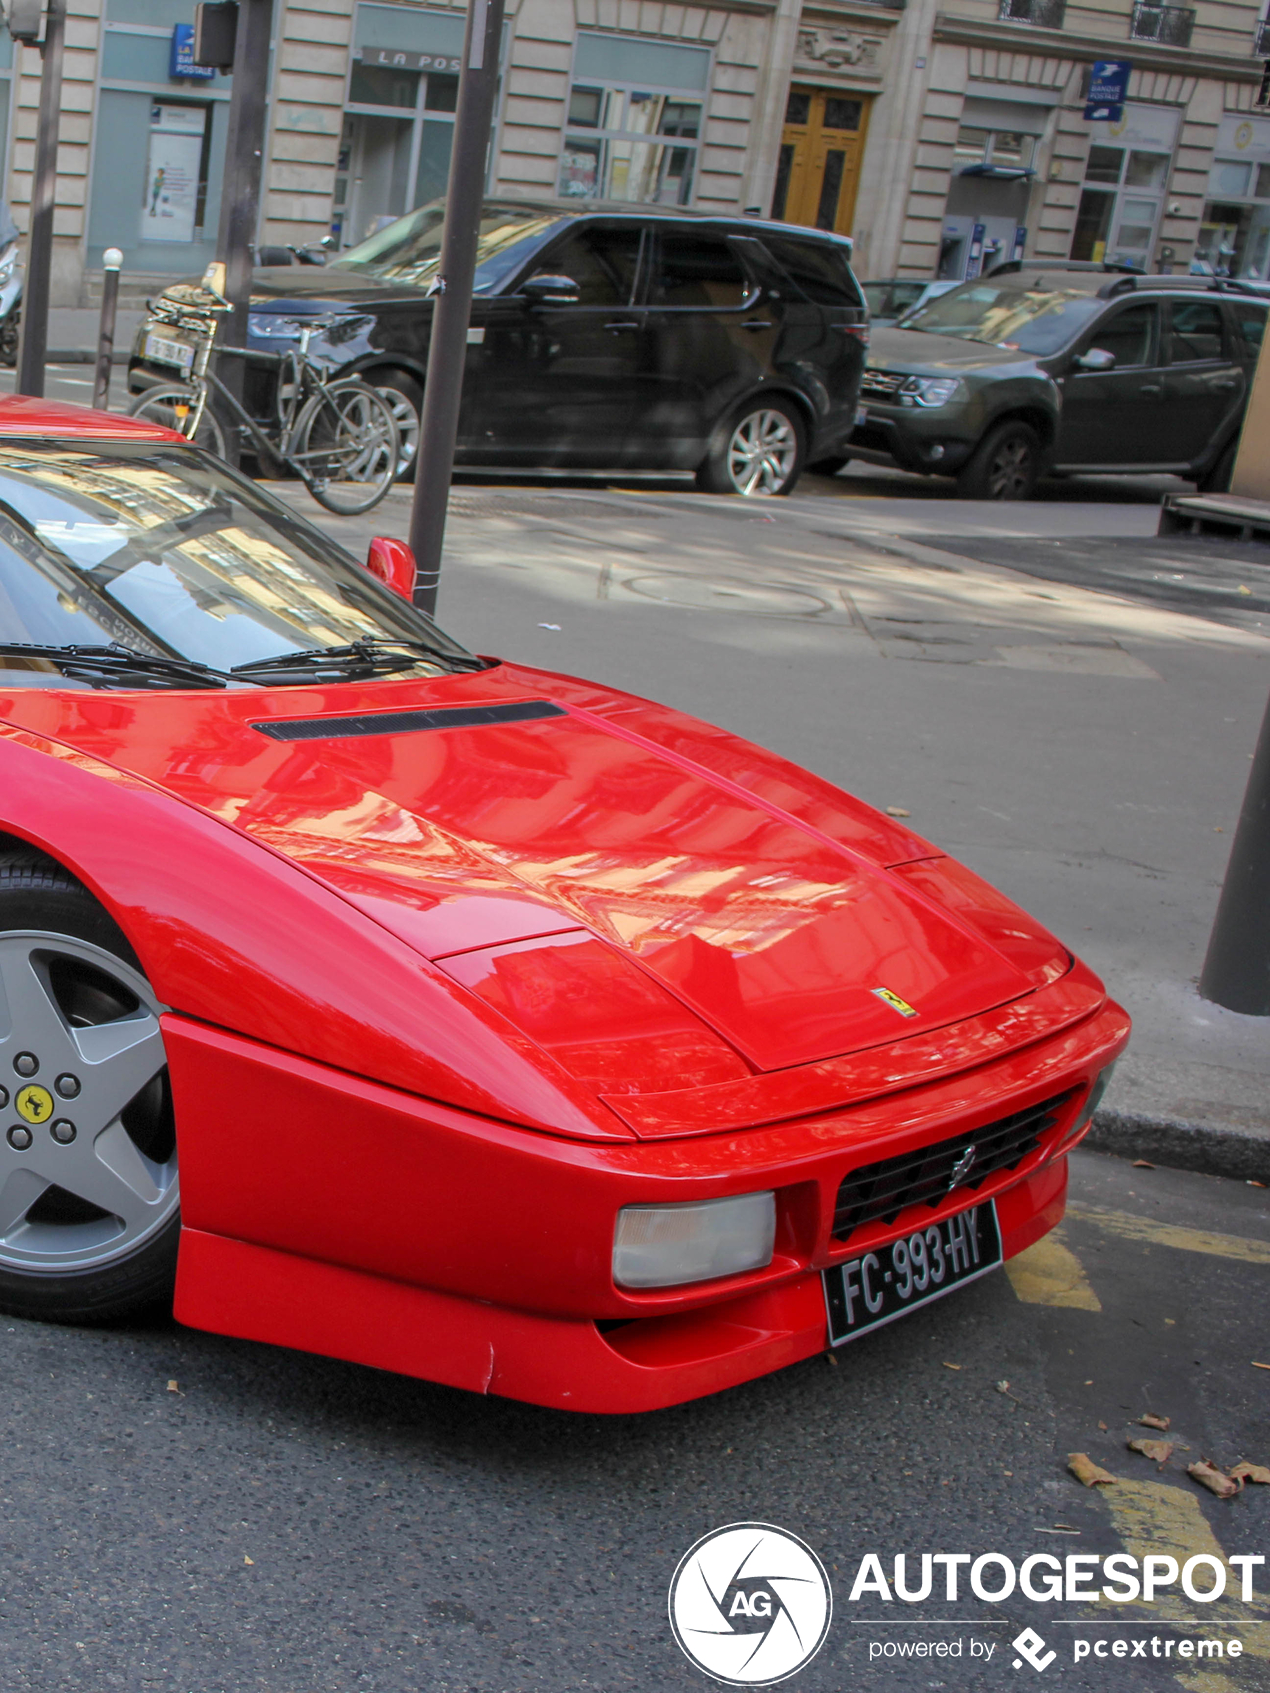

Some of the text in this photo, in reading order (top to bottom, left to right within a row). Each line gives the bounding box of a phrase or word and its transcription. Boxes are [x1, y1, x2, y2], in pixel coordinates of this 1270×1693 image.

[178, 46, 190, 54] LA
[378, 51, 462, 71] LA POS
[176, 64, 213, 75] POSTALE
[1091, 85, 1121, 93] BANQUE
[1090, 92, 1119, 100] POSTALE
[842, 1206, 979, 1325] FC-993-HY
